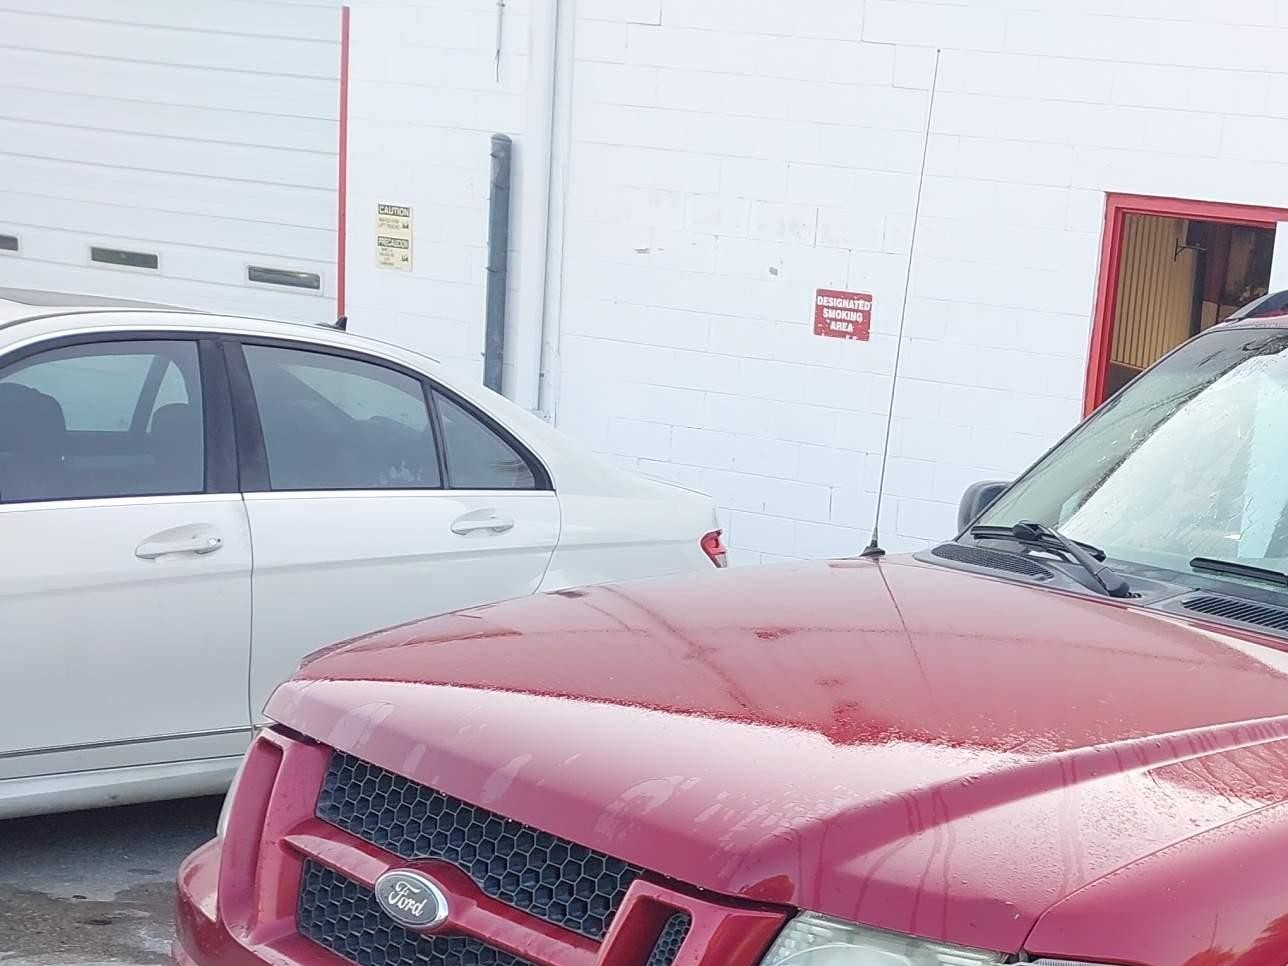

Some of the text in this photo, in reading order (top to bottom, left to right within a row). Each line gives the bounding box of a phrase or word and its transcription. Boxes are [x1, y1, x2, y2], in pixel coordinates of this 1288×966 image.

[379, 205, 409, 216] CAUTION
[817, 296, 870, 311] DESIGNATED
[823, 308, 863, 322] SMOKING
[830, 321, 853, 333] AREA
[388, 880, 428, 917] Ford
